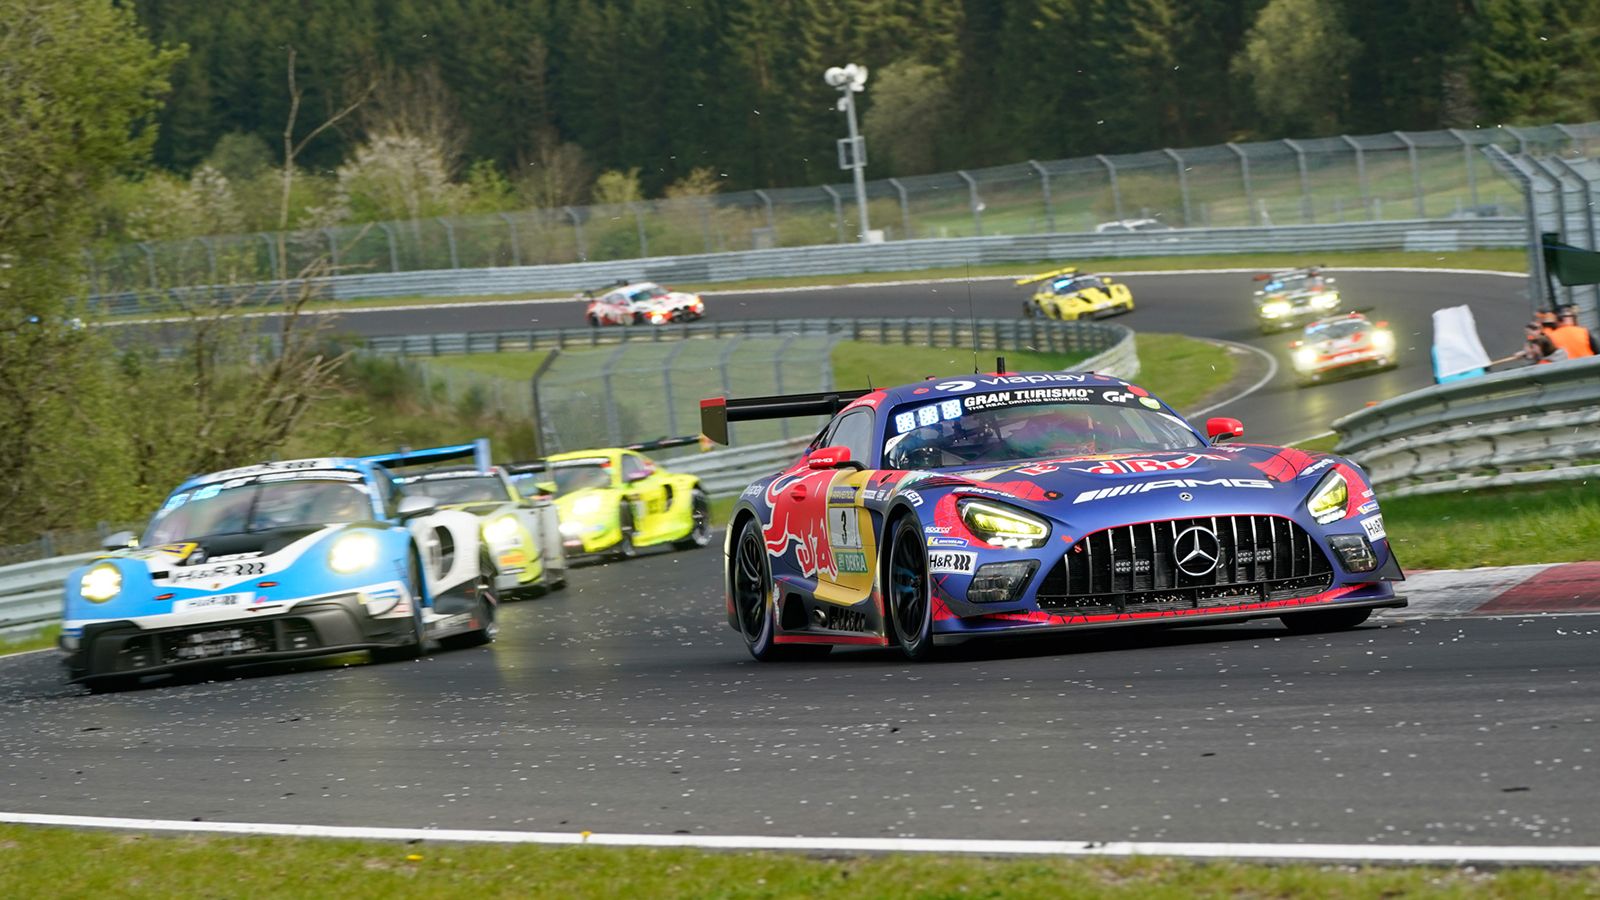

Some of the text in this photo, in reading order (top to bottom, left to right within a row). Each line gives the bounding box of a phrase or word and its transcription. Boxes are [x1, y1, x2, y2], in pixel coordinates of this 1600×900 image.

[964, 388, 1089, 407] GRAN TURISMO
[1139, 478, 1275, 492] AMG
[840, 510, 848, 545] 3
[929, 553, 952, 568] H&R
